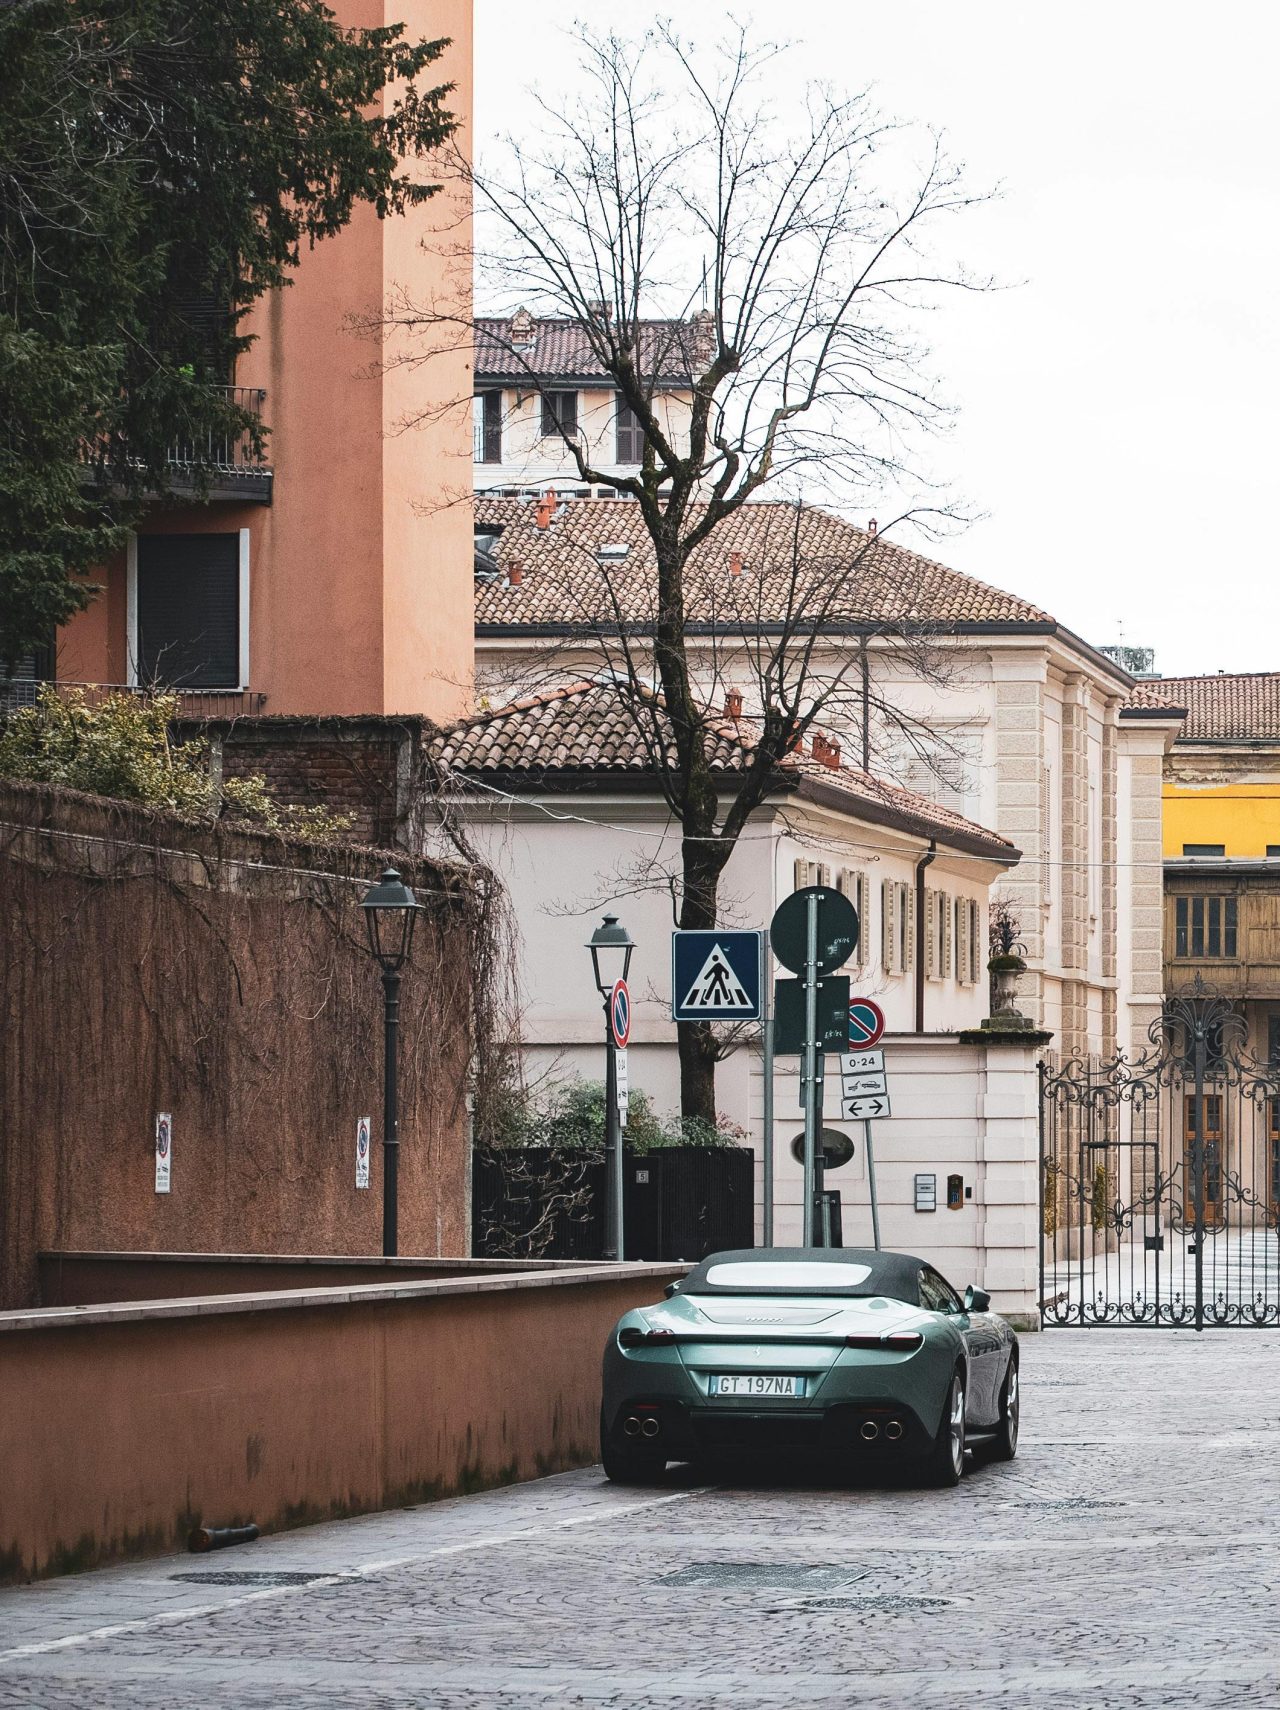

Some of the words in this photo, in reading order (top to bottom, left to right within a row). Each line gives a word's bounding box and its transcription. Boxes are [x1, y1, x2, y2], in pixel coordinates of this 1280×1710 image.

[849, 1057, 876, 1068] 0-24
[720, 1377, 740, 1393] GT
[747, 1377, 793, 1394] 197NA
